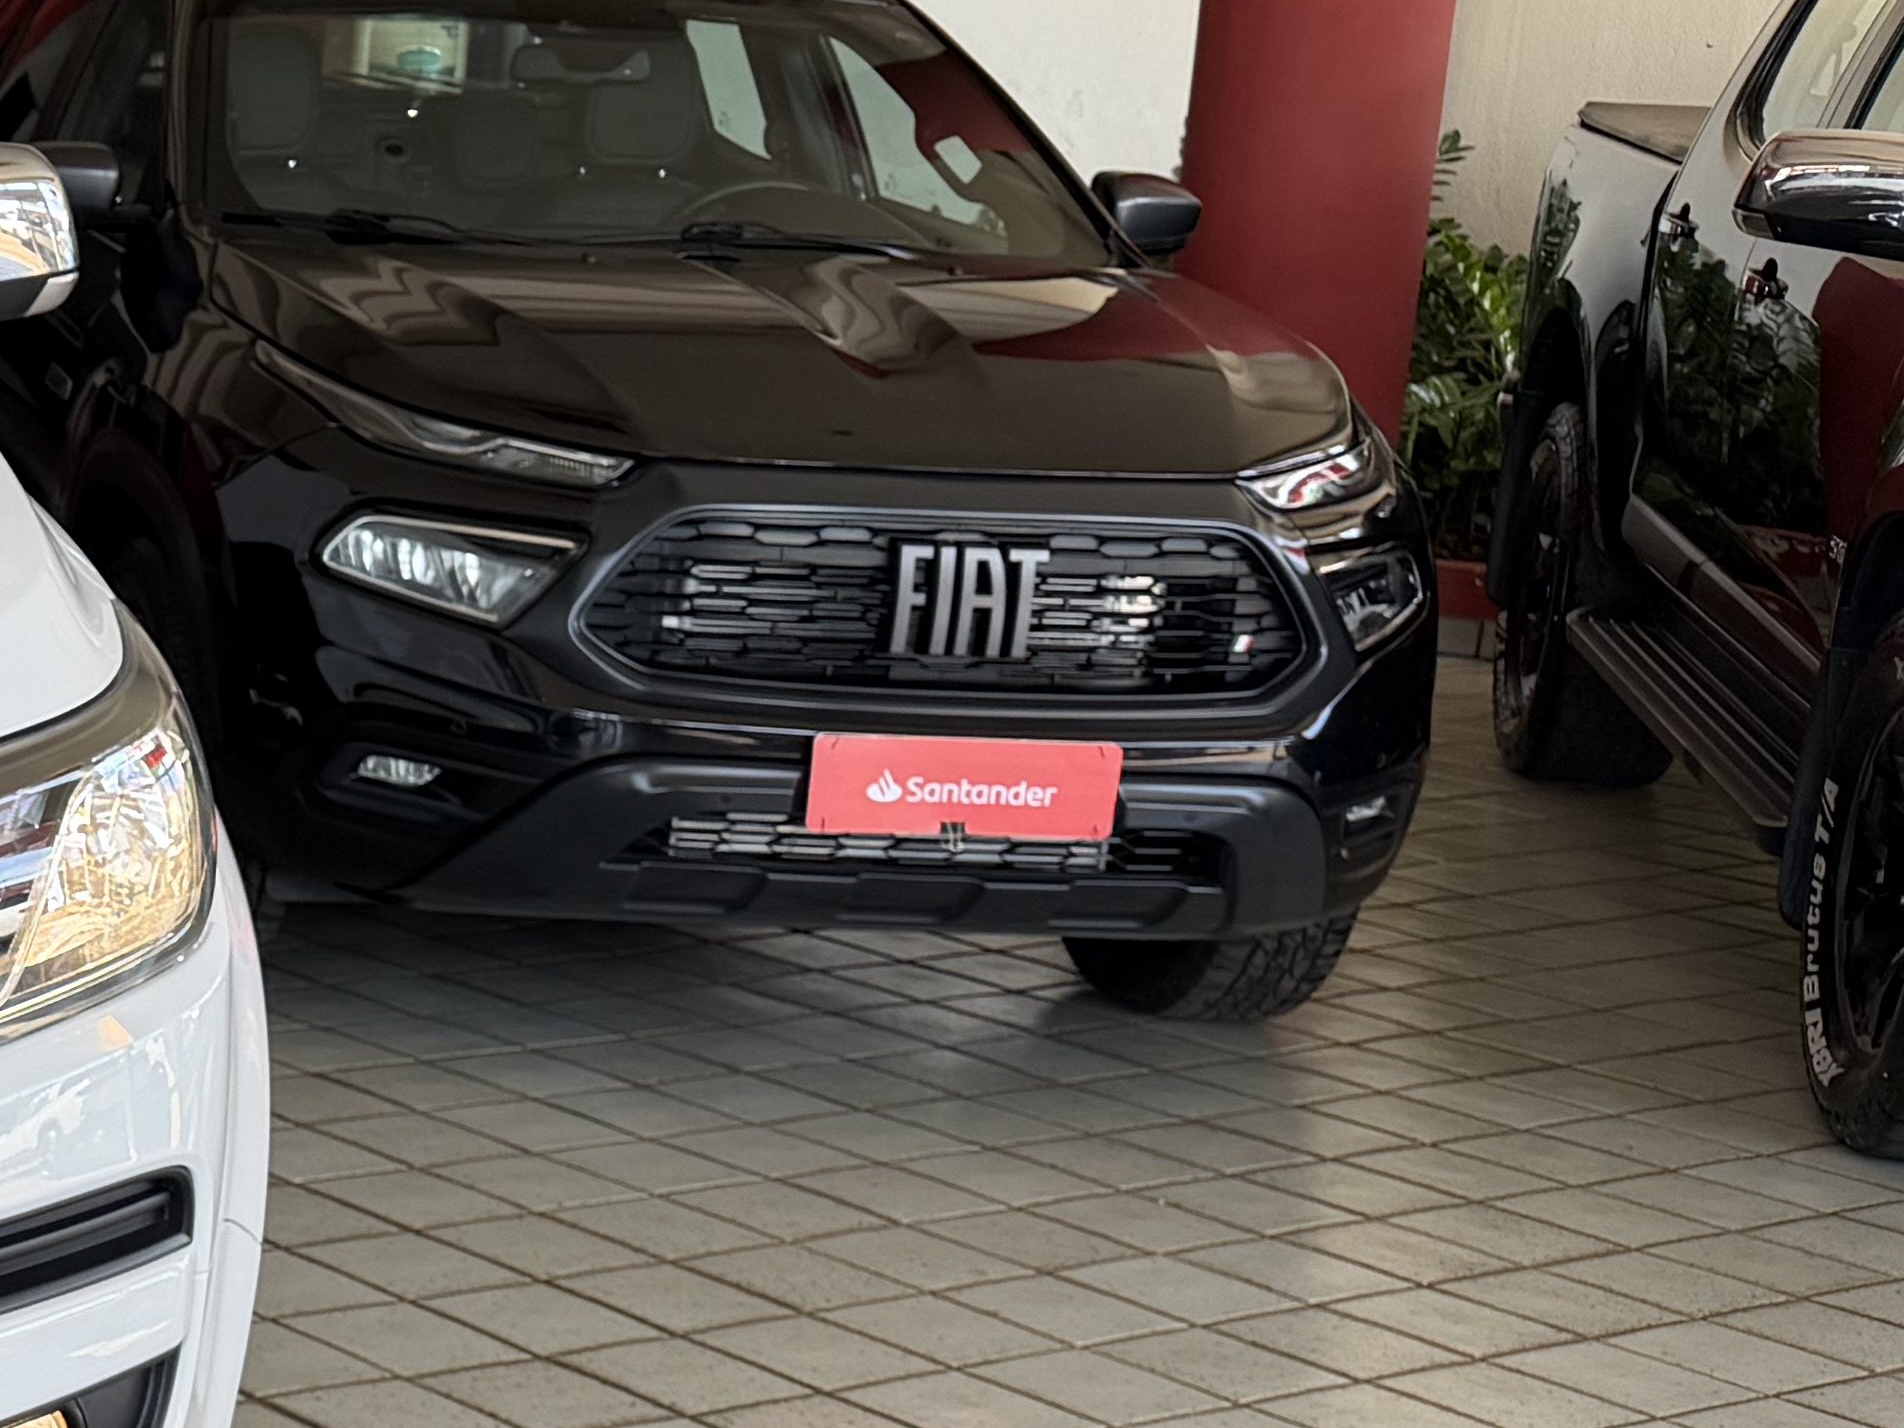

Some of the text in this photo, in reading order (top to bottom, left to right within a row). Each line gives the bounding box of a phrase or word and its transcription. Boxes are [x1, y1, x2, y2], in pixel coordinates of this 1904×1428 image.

[891, 544, 1050, 659] FIAT
[906, 774, 1057, 808] Santander
[1803, 852, 1827, 1002] Brutus
